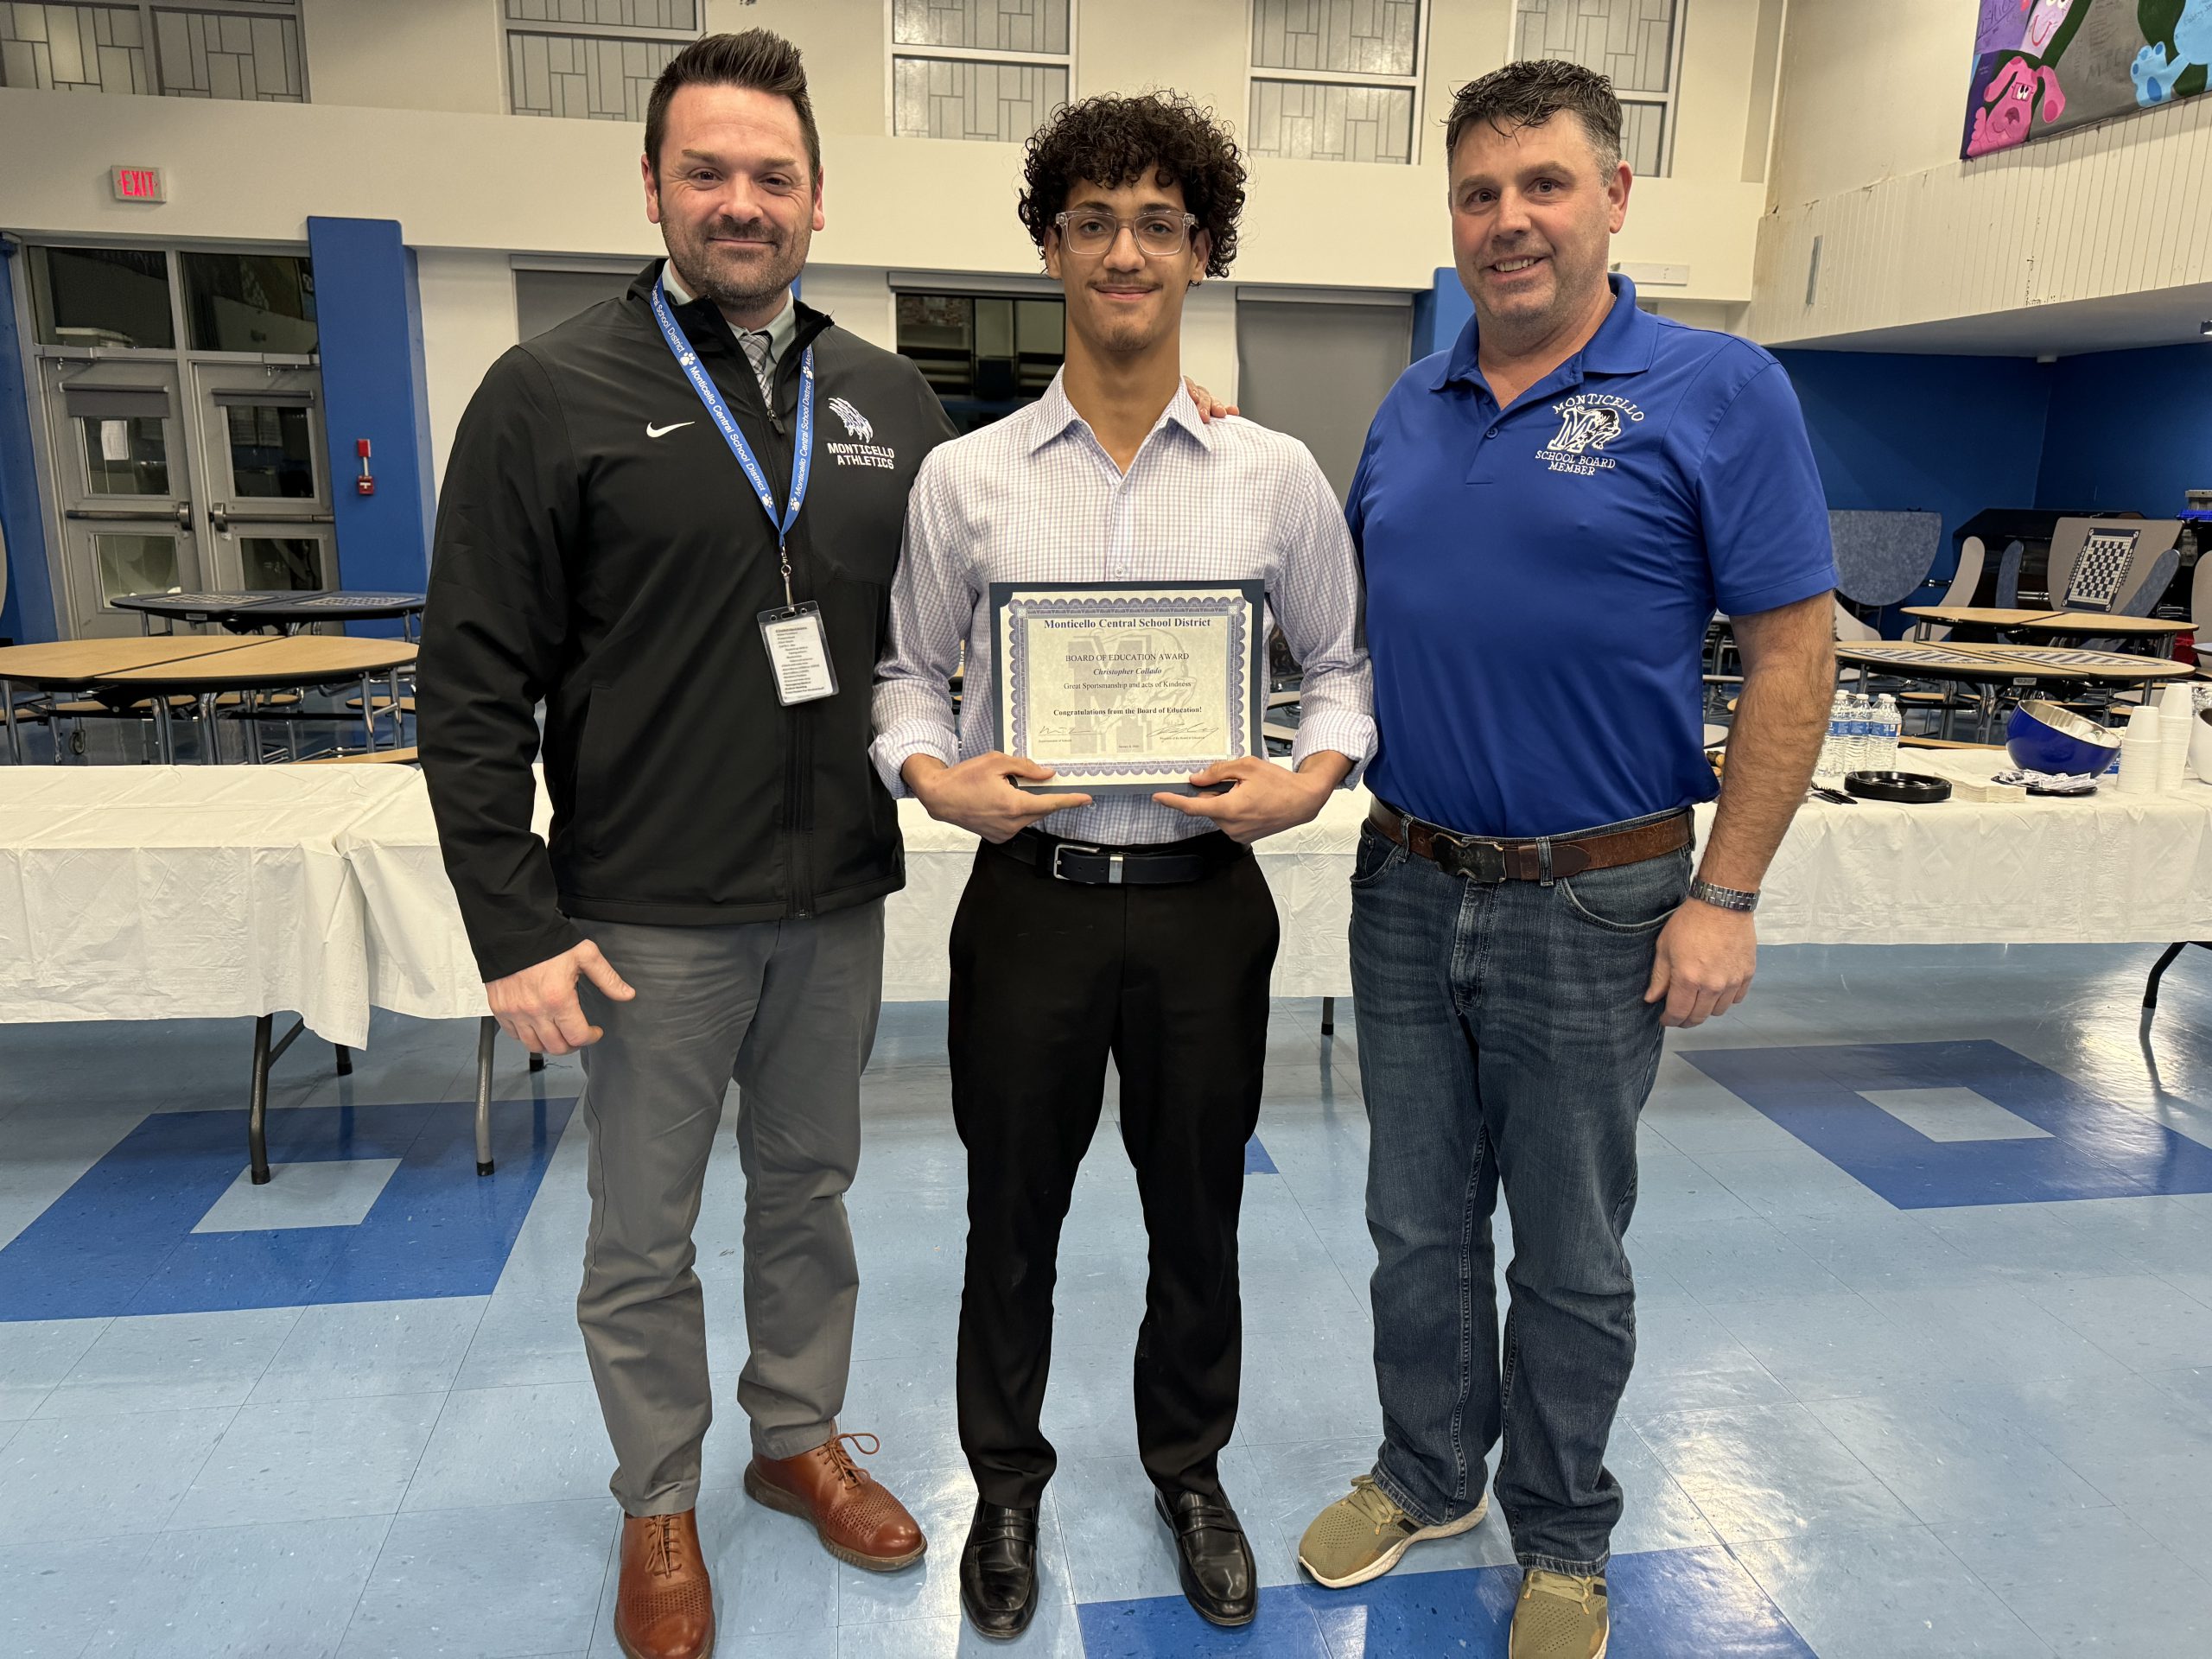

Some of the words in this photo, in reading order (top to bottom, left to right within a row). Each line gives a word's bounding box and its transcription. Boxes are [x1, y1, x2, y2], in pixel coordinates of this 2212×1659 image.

[120, 169, 154, 197] EXIT
[657, 304, 671, 328] School
[667, 327, 685, 353] District
[803, 379, 811, 406] District
[801, 406, 810, 430] School
[1552, 393, 1645, 422] MONTICELLO
[690, 365, 715, 405] Monticello
[713, 404, 734, 434] Central
[730, 433, 751, 462] School
[746, 463, 766, 491] District
[799, 432, 810, 457] Central
[827, 442, 895, 459] MONTICELLO
[837, 454, 894, 470] ATHLETICS
[1535, 450, 1576, 463] SCHOOL
[1580, 455, 1616, 469] BOARD
[1548, 461, 1596, 475] MEMBER
[794, 458, 807, 497] Monticello
[1044, 619, 1096, 629] Monticello
[1099, 618, 1136, 628] Central
[1139, 618, 1171, 627] School
[1174, 617, 1211, 627] District
[1093, 668, 1134, 677] Christopher
[1135, 666, 1162, 675] Collado
[1082, 682, 1128, 690] Sportsmanship
[1053, 709, 1106, 717] Congratulations
